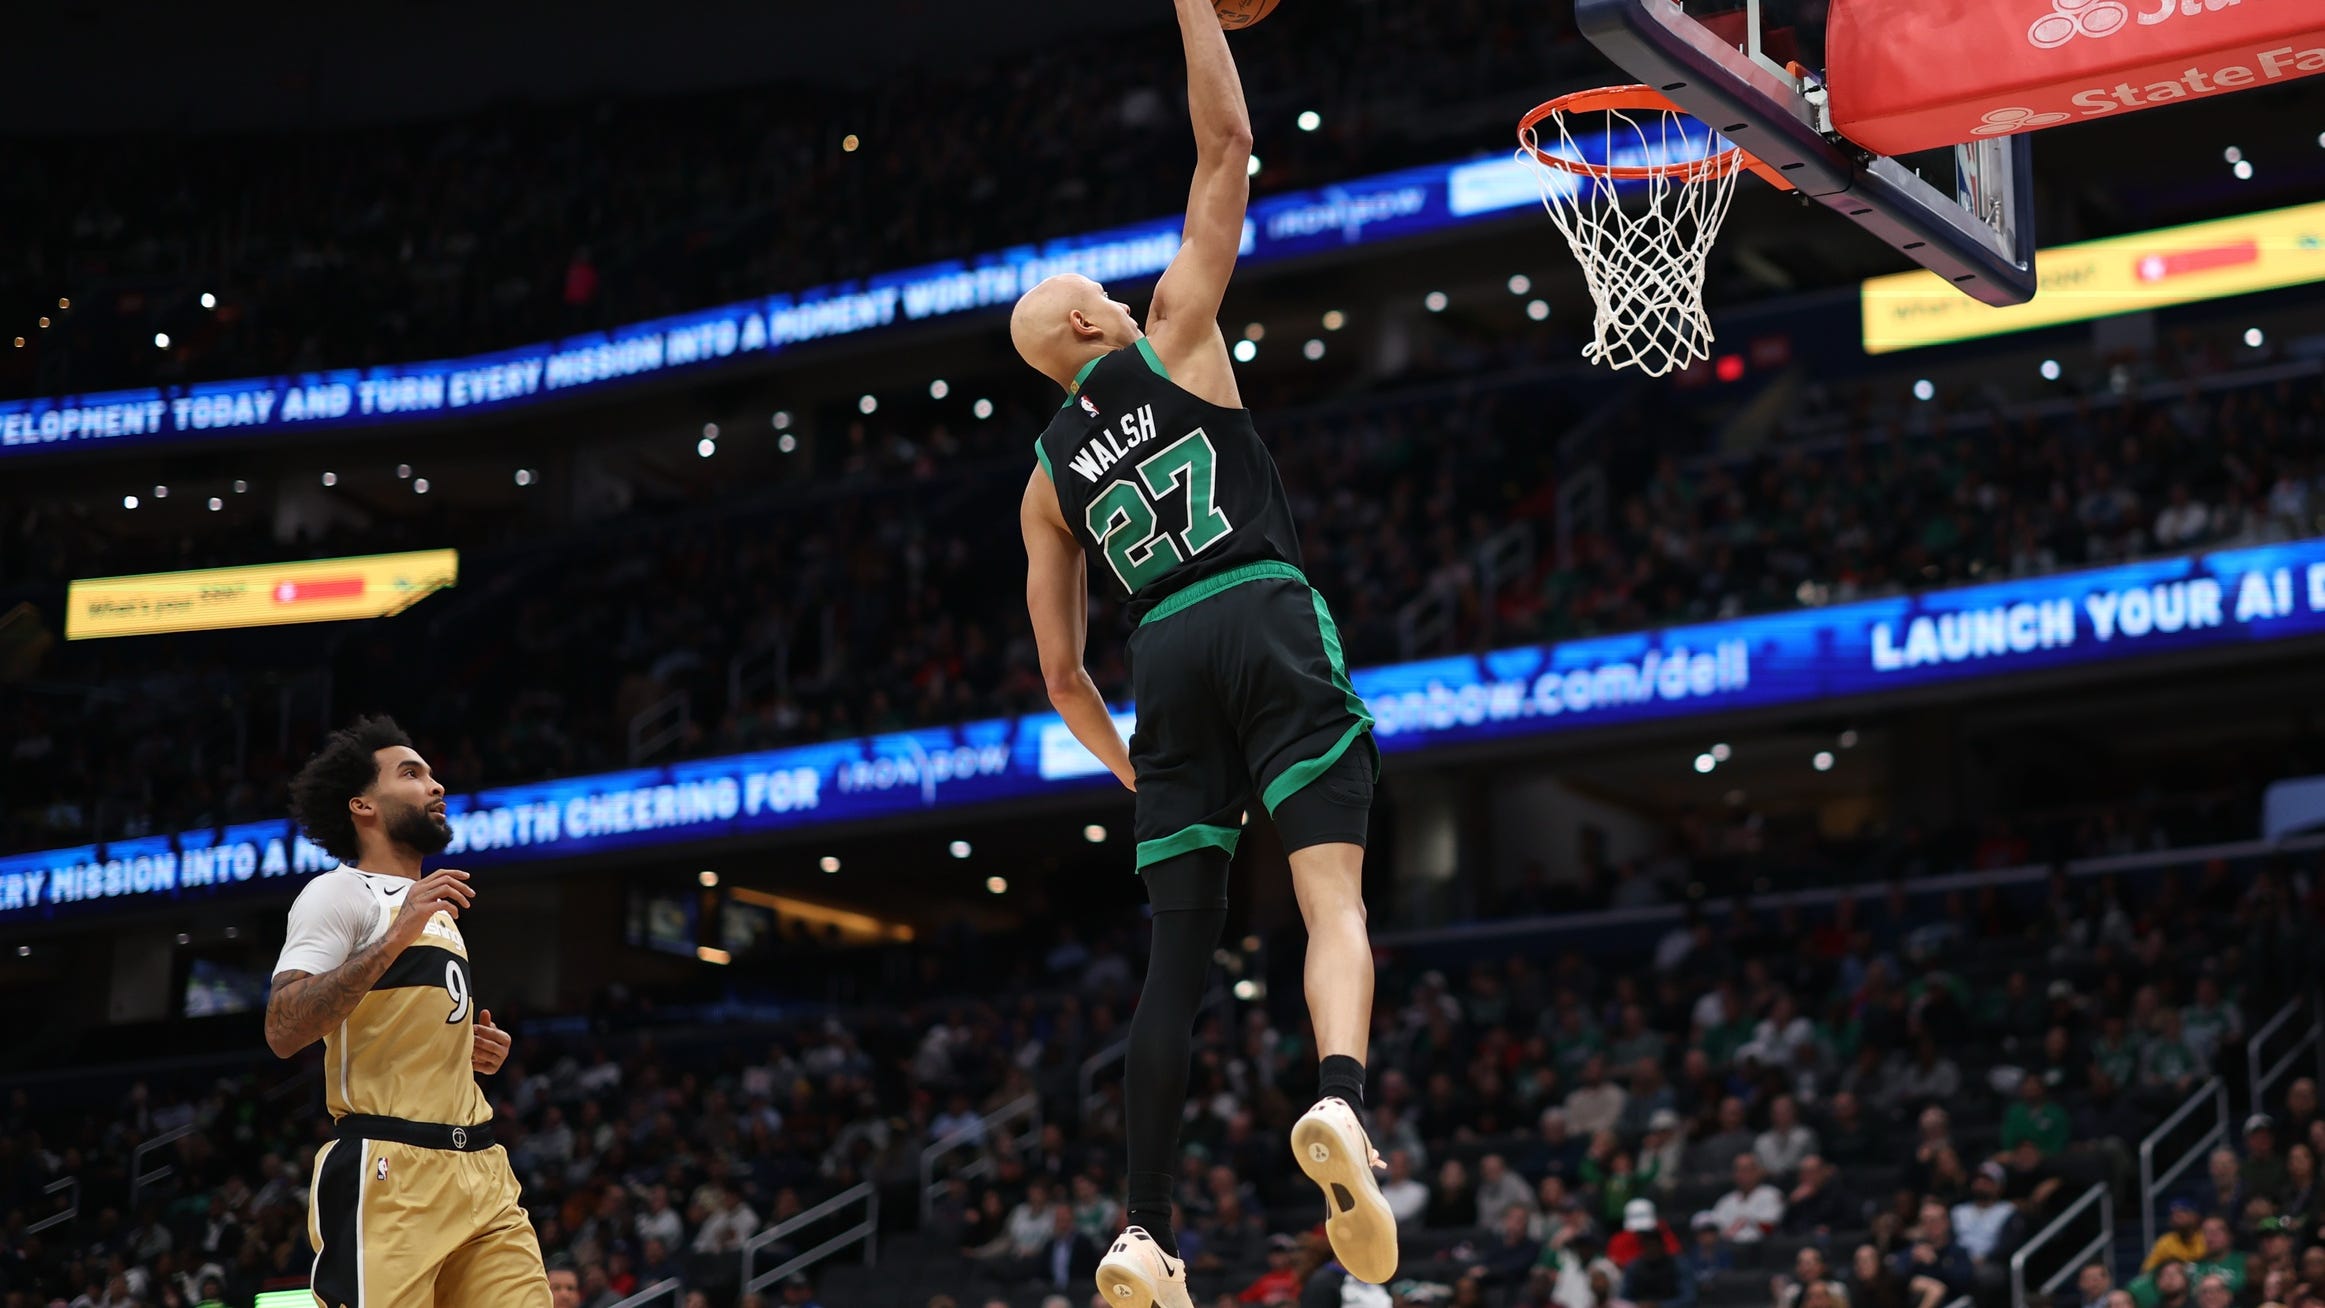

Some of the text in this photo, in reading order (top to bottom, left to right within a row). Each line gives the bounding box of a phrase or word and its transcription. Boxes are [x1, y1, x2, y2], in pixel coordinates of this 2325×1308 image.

[2071, 67, 2255, 115] State
[0, 400, 164, 446] ELOPMENT
[173, 389, 275, 431] TODAY
[281, 382, 350, 421] AND
[358, 375, 443, 414] TURN
[448, 357, 542, 408] EVERY
[545, 334, 664, 389] MISSION
[665, 318, 738, 367] INTO
[740, 312, 767, 352] A
[768, 286, 898, 340] MOMENT
[1068, 403, 1157, 484] WALSH
[1085, 427, 1234, 595] 27
[1871, 598, 2075, 672] LAUNCH
[2084, 578, 2222, 642] YOUR
[2234, 568, 2294, 623] AI
[1364, 638, 1750, 736] onbow.com/dell
[564, 776, 740, 839] CHEERING
[743, 766, 819, 816] FOR
[0, 869, 46, 911] RY
[49, 851, 176, 905] MISSION
[181, 841, 257, 887] INTO
[261, 837, 288, 878] A
[445, 959, 469, 1024] 9
